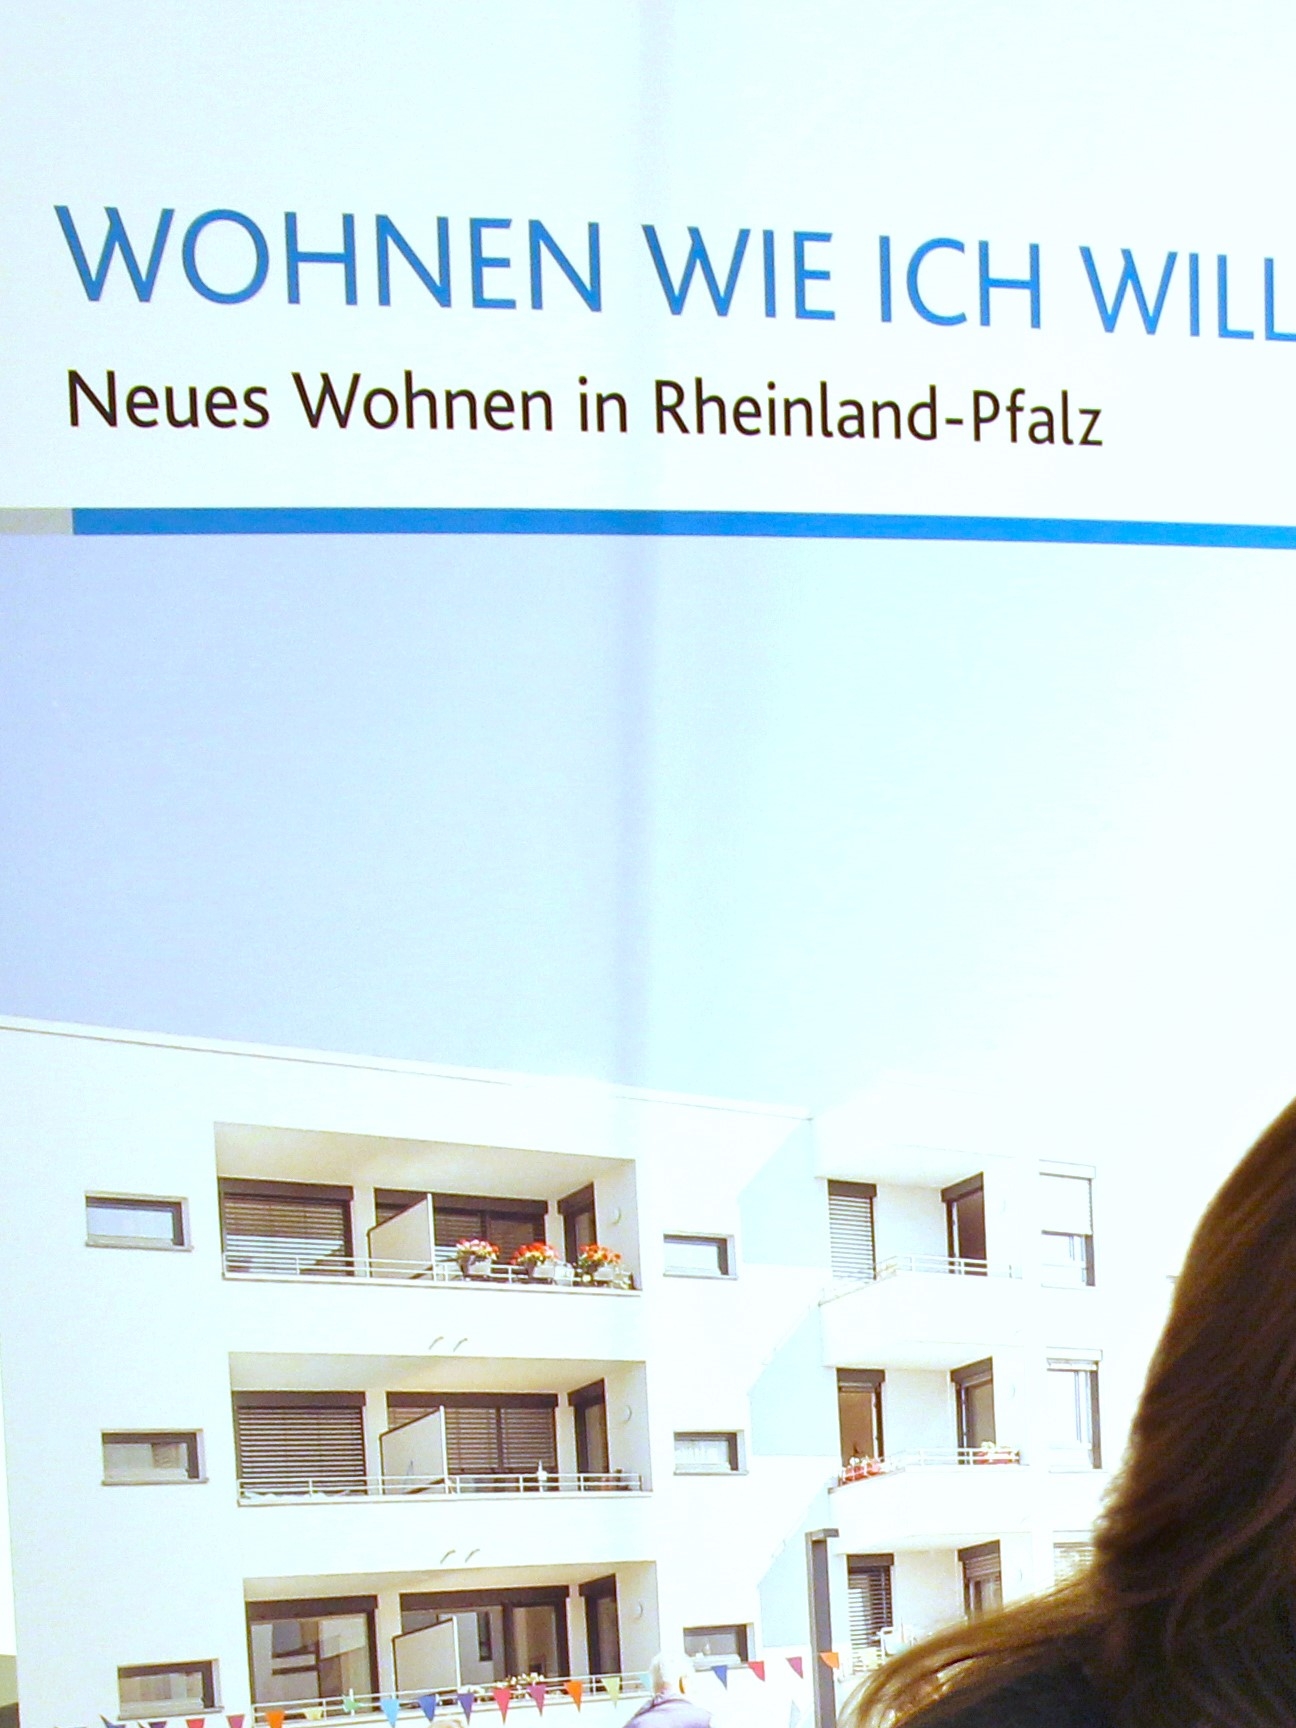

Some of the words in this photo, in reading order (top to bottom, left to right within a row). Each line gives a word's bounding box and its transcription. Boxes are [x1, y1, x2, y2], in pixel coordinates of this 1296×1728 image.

[53, 205, 602, 312] WOHNEN
[641, 224, 836, 320] WIE
[878, 235, 1041, 329] ICH
[67, 369, 270, 428] Neues
[291, 369, 553, 432] Wohnen
[577, 375, 628, 432] in
[654, 376, 1103, 446] Rheinland-Pfalz
